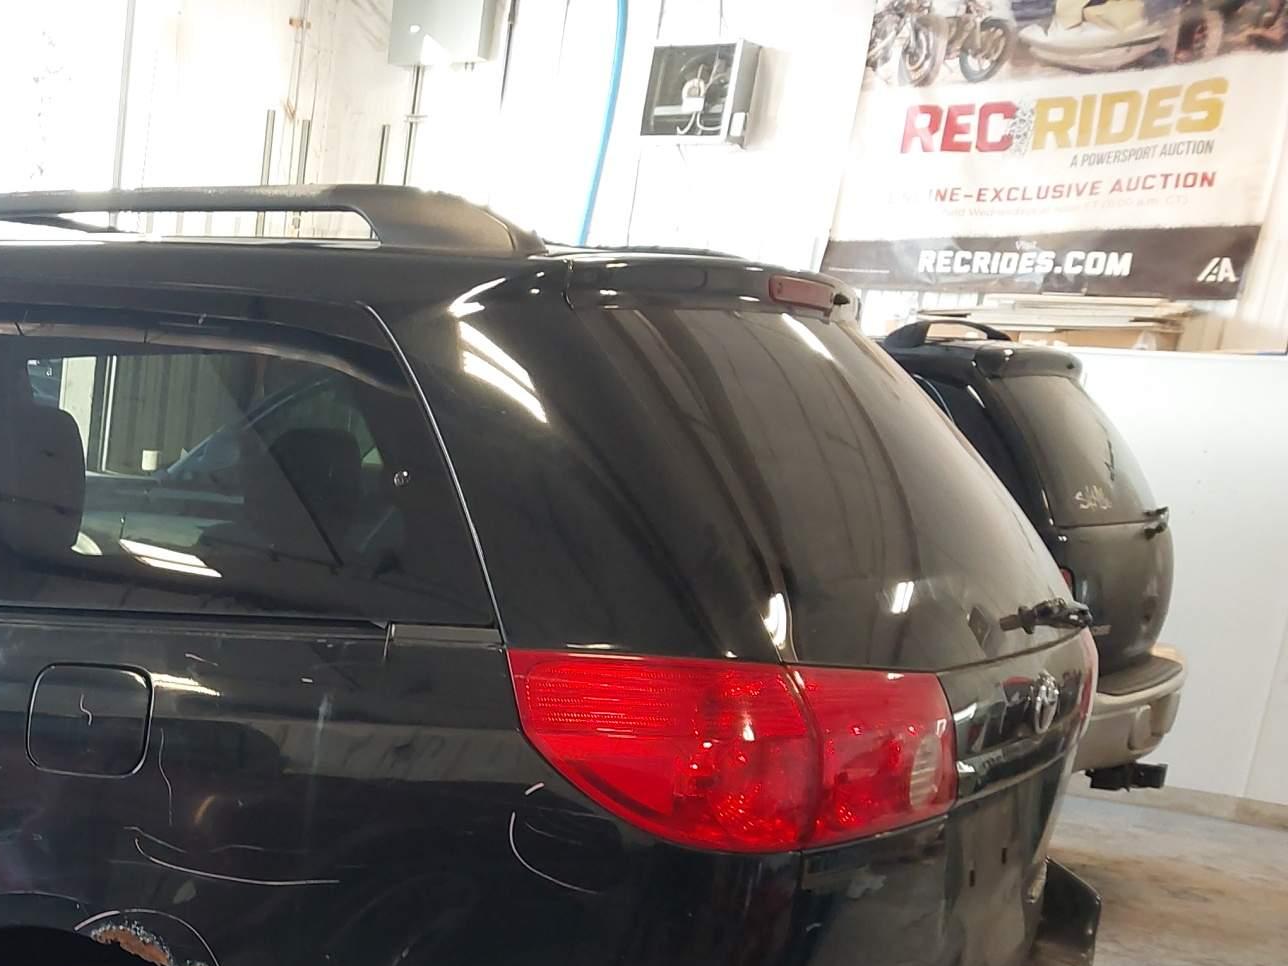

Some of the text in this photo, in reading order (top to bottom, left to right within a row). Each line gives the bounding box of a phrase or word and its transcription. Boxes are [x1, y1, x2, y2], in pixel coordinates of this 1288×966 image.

[900, 77, 1229, 154] REC RIDES
[1070, 139, 1216, 168] A POWERSPORT AUCTION
[1109, 171, 1217, 195] AUCTION
[918, 250, 1133, 277] RECRIDES.COM
